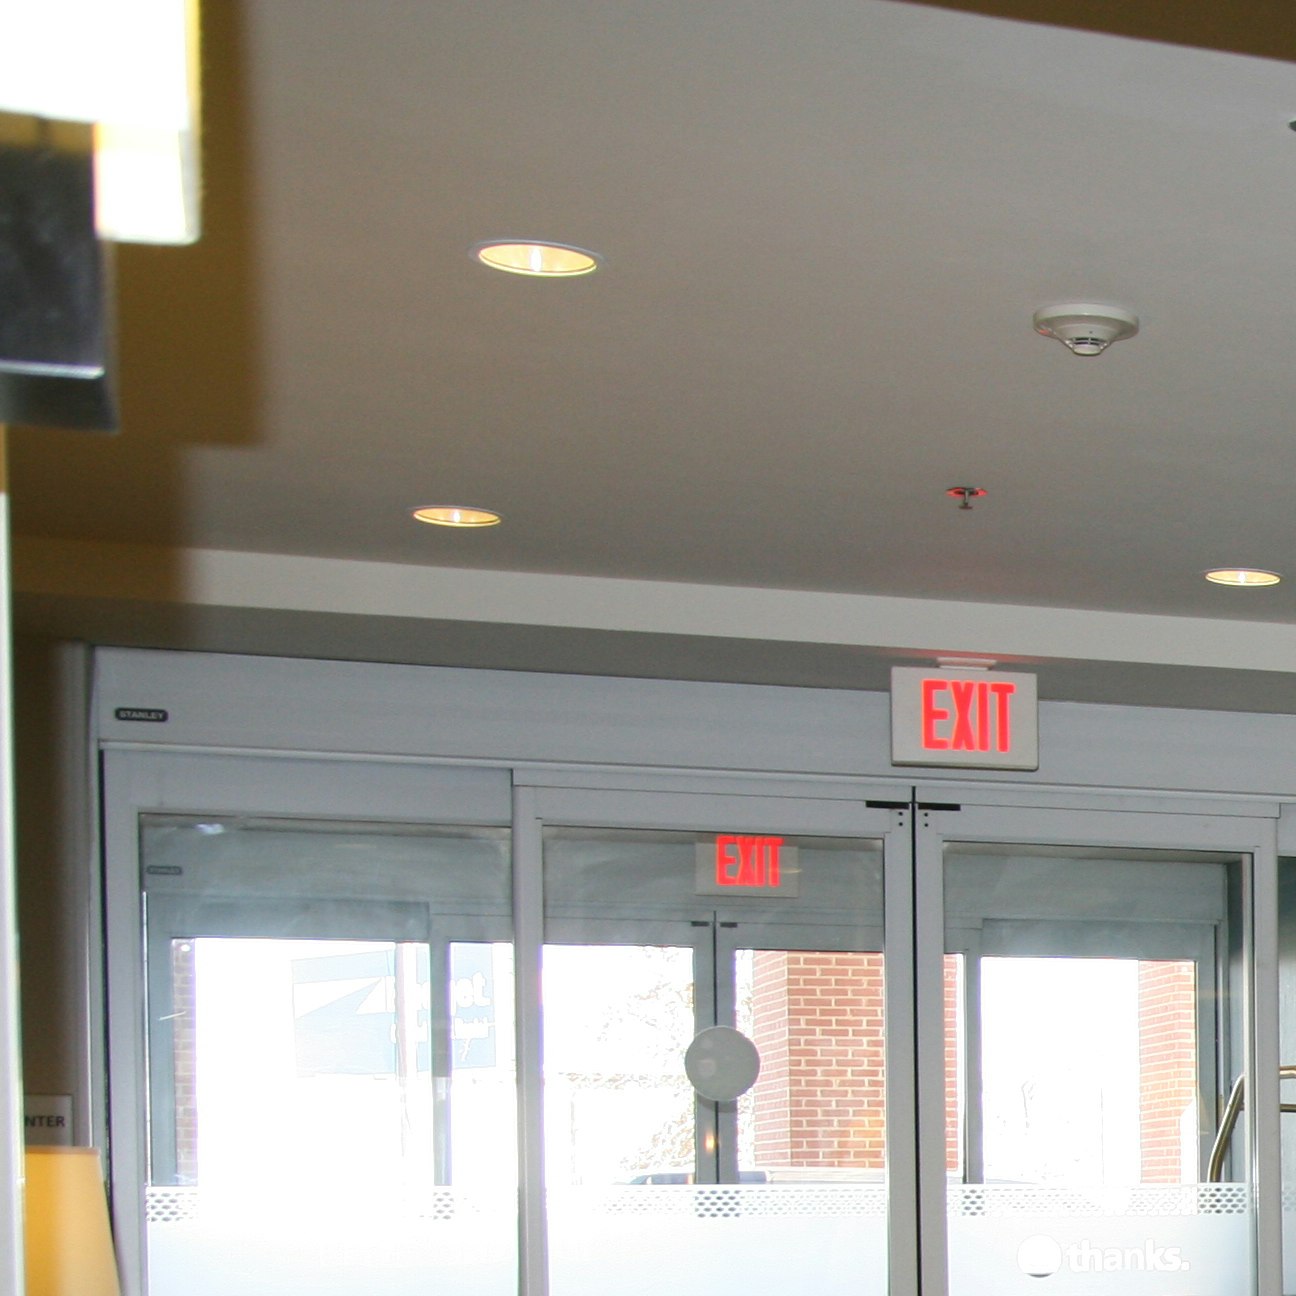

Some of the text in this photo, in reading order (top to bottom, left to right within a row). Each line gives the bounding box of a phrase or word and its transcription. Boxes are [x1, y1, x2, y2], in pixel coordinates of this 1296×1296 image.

[119, 710, 164, 719] STANLEY
[922, 679, 1016, 753] EXIT
[716, 834, 784, 888] EXIT
